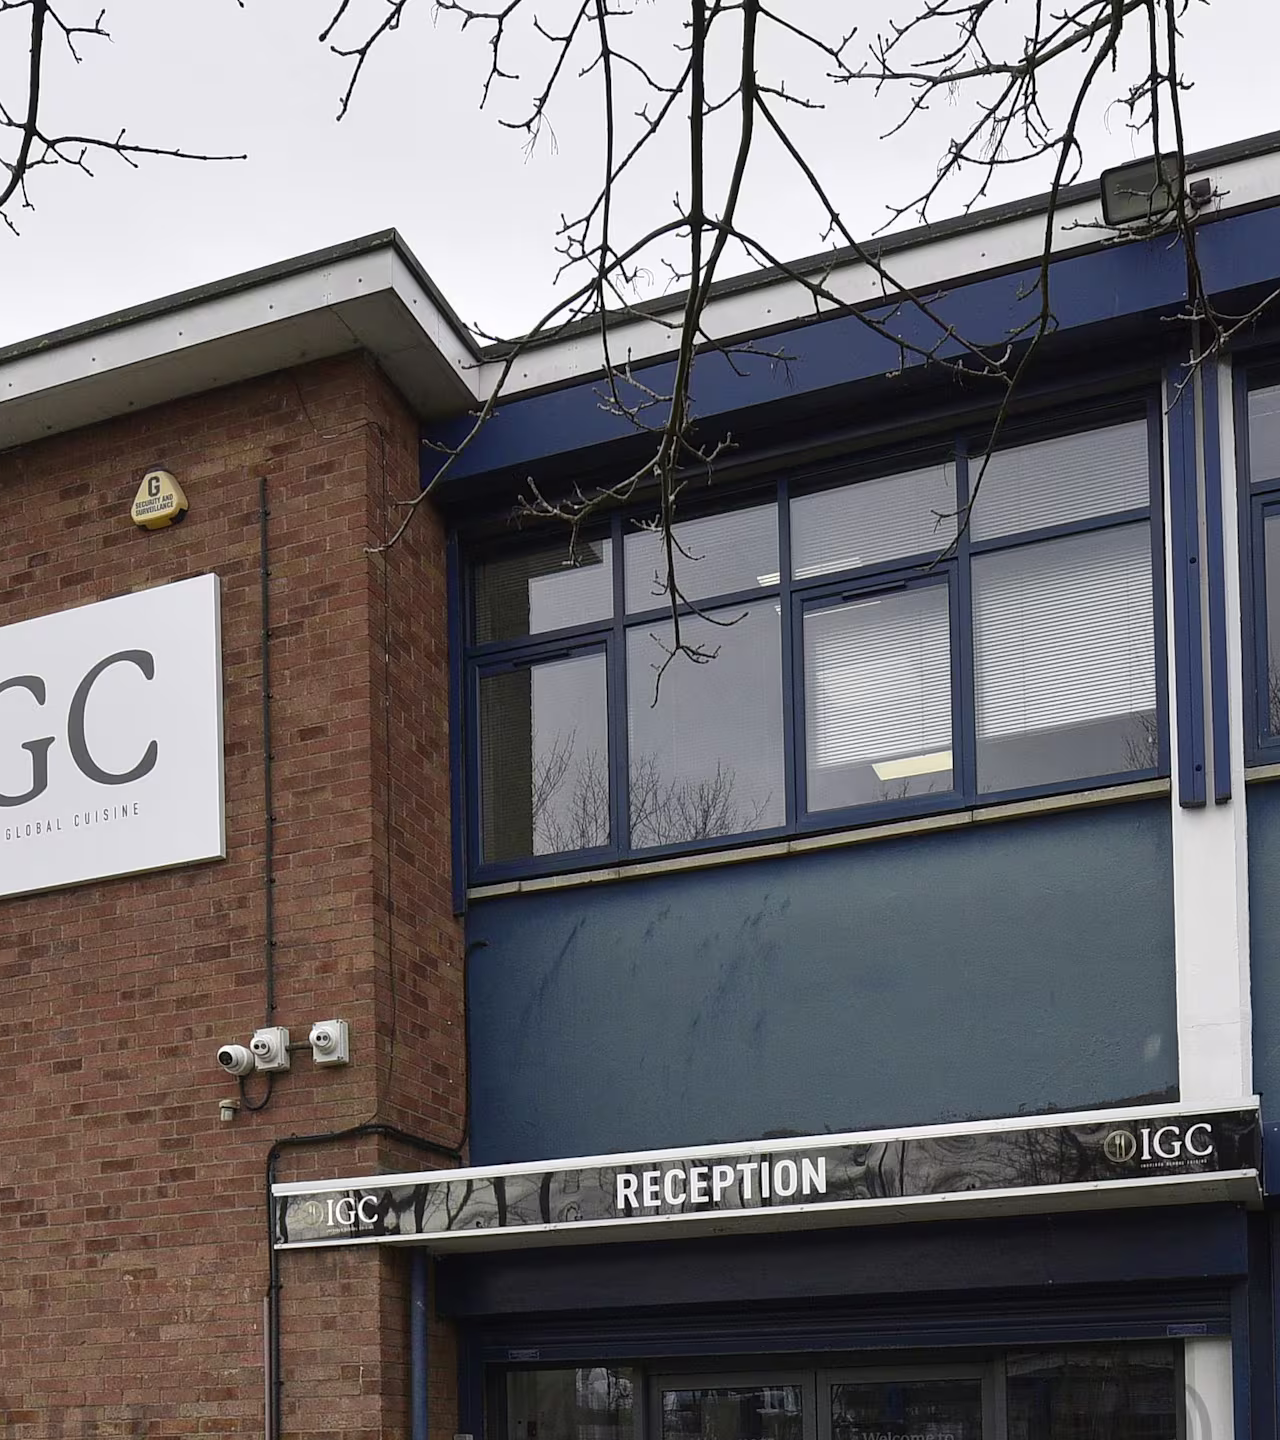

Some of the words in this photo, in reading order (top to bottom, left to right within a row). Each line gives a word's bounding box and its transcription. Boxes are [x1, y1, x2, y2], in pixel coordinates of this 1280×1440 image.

[135, 497, 160, 510] SECURITY
[162, 493, 174, 503] AND
[147, 476, 161, 498] G
[135, 501, 174, 517] SURVEILLANCE
[5, 818, 62, 841] GLOBAL
[73, 802, 140, 827] CUISINE
[1140, 1122, 1214, 1160] IGC
[616, 1156, 827, 1209] RECEPTION
[326, 1195, 379, 1226] IGC
